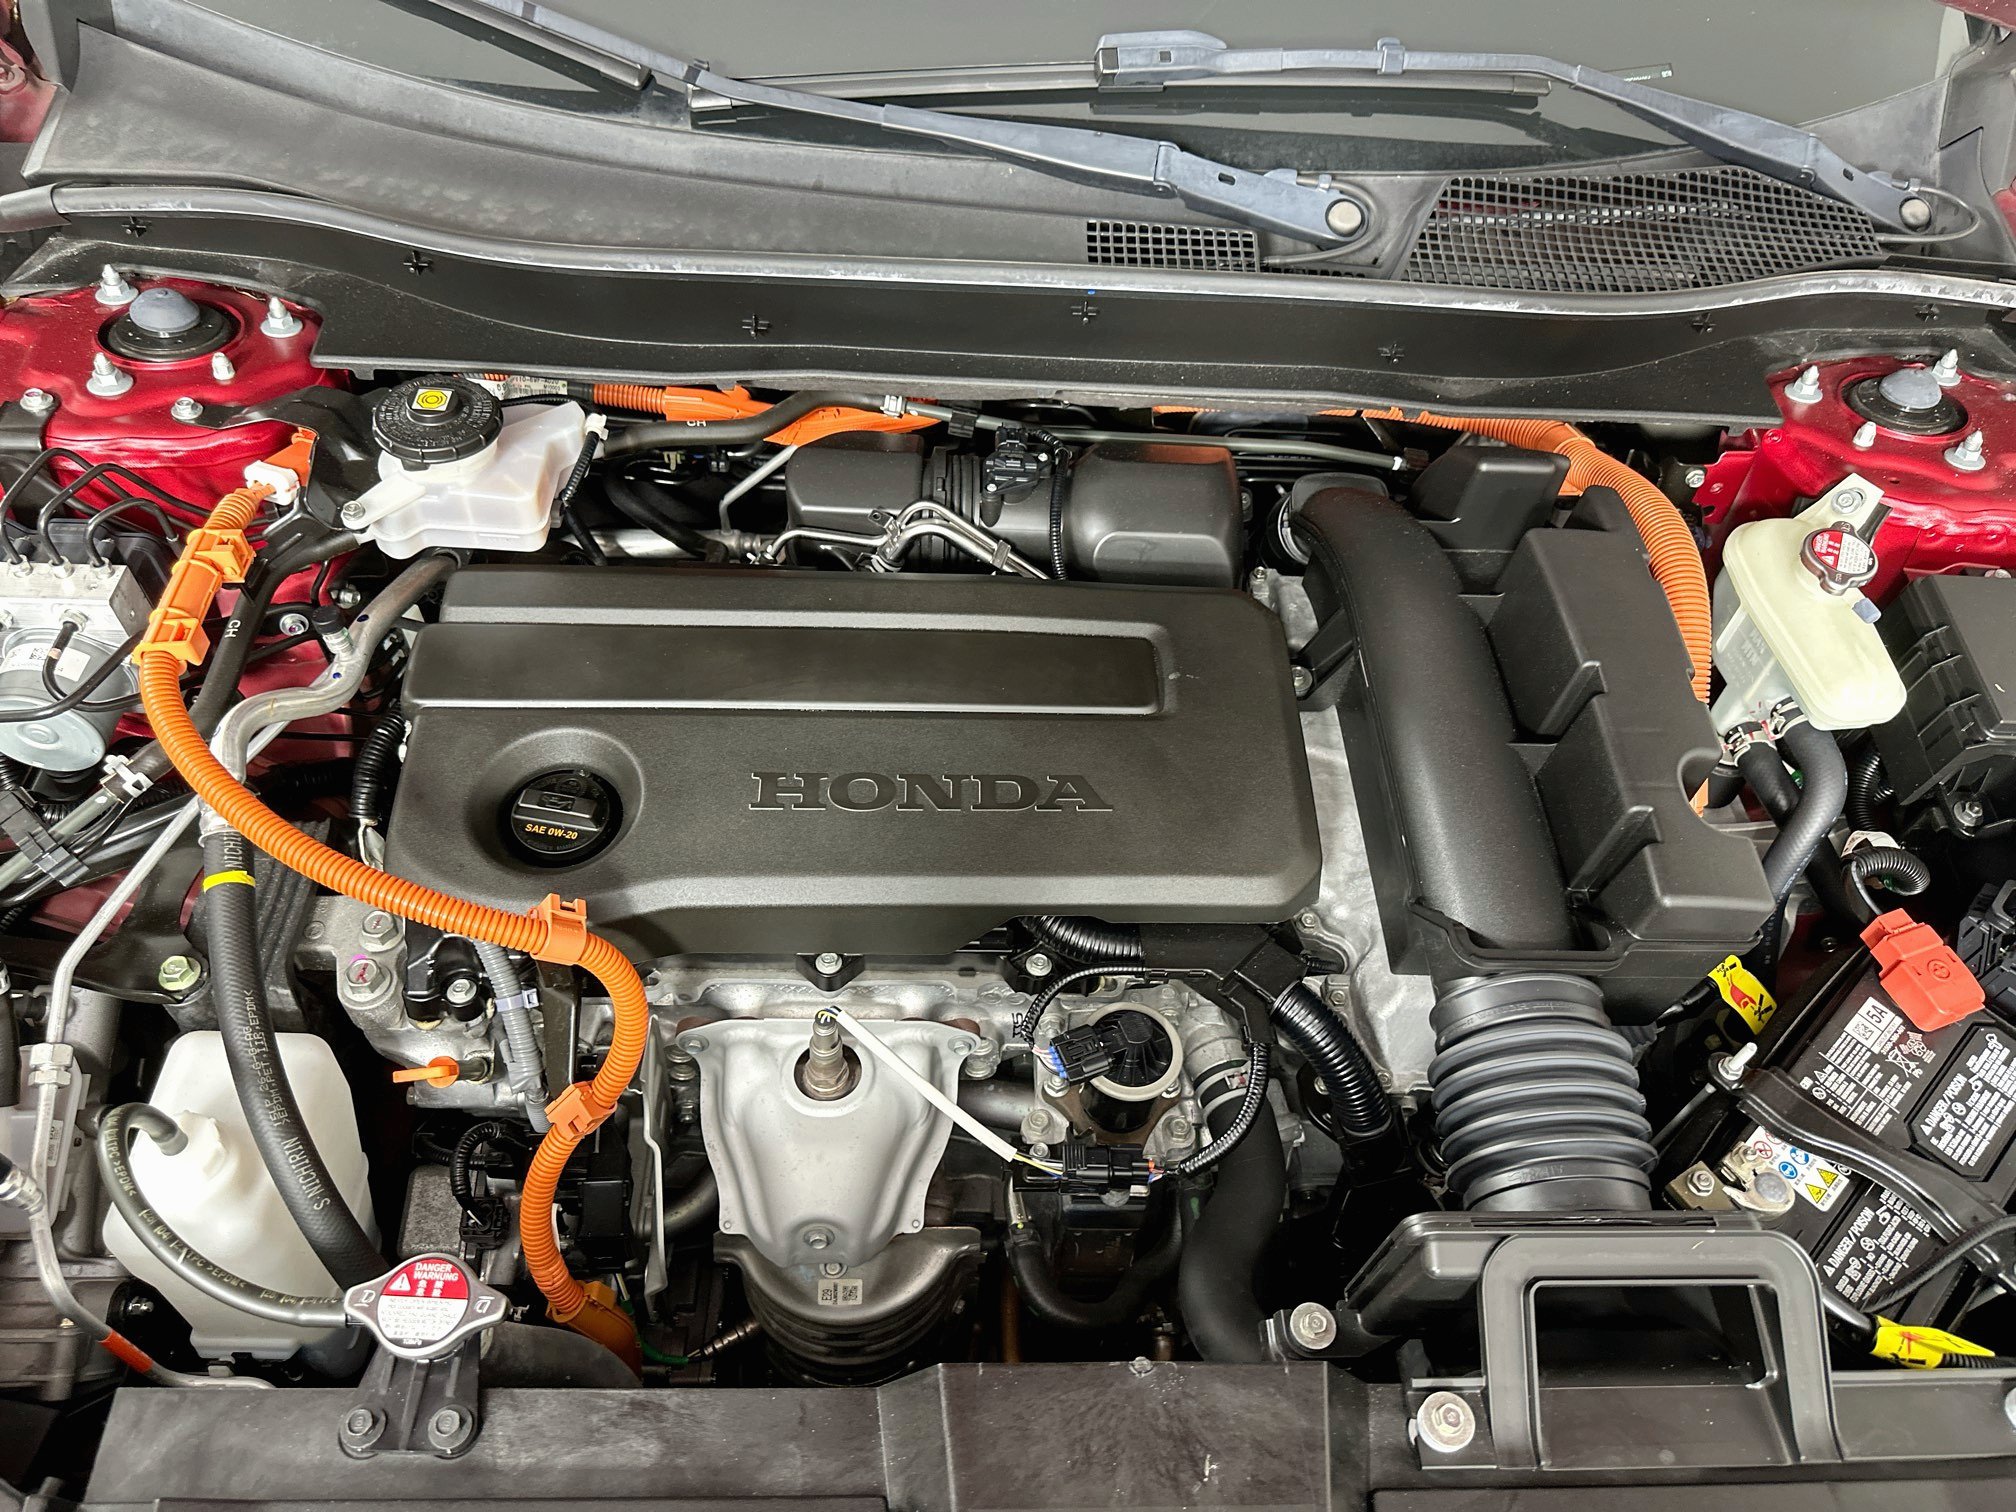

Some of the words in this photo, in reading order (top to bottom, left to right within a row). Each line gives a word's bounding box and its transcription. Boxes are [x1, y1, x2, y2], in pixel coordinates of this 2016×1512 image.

[225, 620, 241, 638] CH
[749, 772, 1113, 811] HONDA
[525, 823, 547, 835] SAE
[547, 827, 578, 840] 0W-20
[1865, 1003, 1887, 1024] 5A
[1925, 1073, 1967, 1127] DANGER/POISON
[1827, 1206, 1875, 1268] DANGER/POISON
[413, 1271, 459, 1281] WARNUNG
[415, 1262, 452, 1273] DANGER
